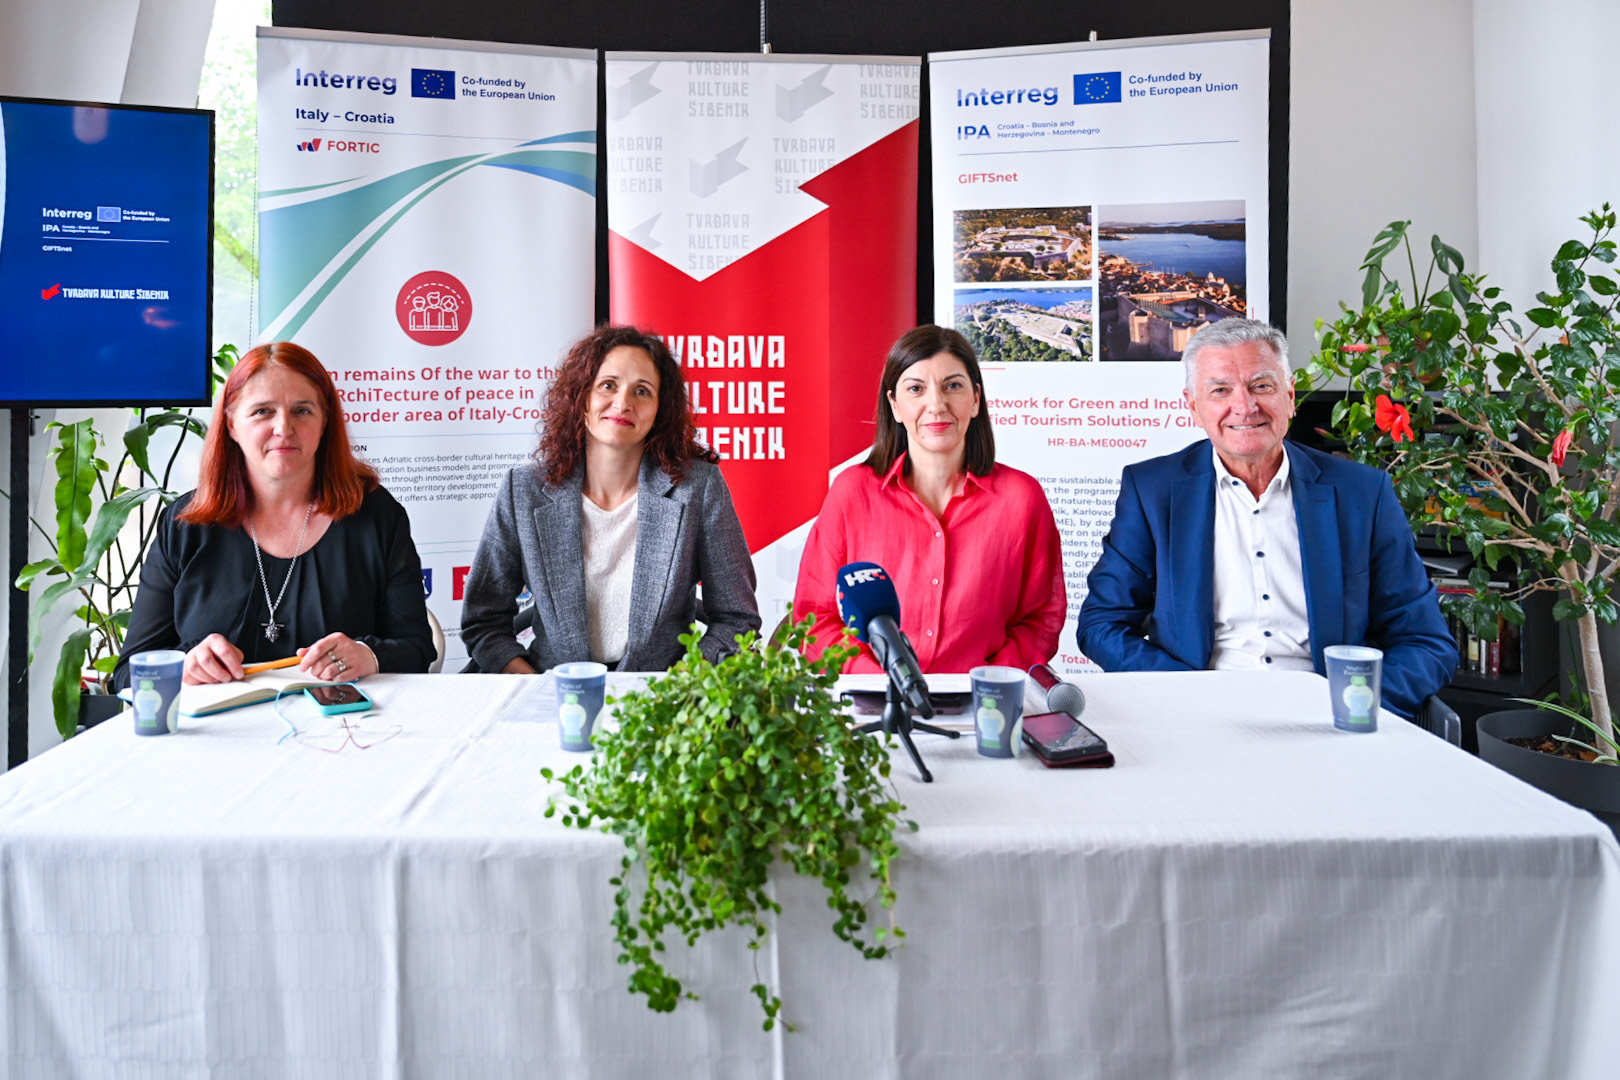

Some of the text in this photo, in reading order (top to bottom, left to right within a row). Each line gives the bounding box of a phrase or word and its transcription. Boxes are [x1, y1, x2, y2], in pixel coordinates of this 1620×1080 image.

[296, 68, 397, 95] Interreg
[462, 76, 526, 89] Co-funded by
[1129, 71, 1202, 84] Co-funded by
[462, 88, 556, 101] the European Union
[689, 82, 749, 96] KULTURE
[860, 84, 919, 99] KULTURE
[1129, 82, 1238, 97] the European Union
[957, 87, 1058, 107] Interreg
[296, 108, 329, 123] Italy
[345, 111, 395, 124] Croatia
[1032, 121, 1058, 129] Bosnia
[957, 125, 991, 140] IPA
[997, 131, 1045, 139] Herzegovina
[1052, 128, 1100, 136] Montenegro
[328, 140, 380, 153] FORTIC
[772, 138, 835, 152] TVRĐAVA
[958, 172, 1018, 184] GIFTSnet
[42, 207, 92, 220] Interreg
[687, 214, 749, 228] TVRĐAVA
[42, 224, 60, 232] IPA
[689, 235, 749, 249] KULTURE
[660, 335, 785, 368] VRĐAVA
[344, 367, 415, 381] remains
[421, 366, 440, 380] Of
[445, 366, 473, 380] the
[478, 369, 509, 380] war
[515, 368, 531, 380] to
[336, 386, 534, 404] RchiTecture of peace in
[986, 397, 1038, 409] etwork
[1043, 397, 1065, 409] for
[1069, 398, 1115, 409] Green
[1119, 398, 1149, 409] and
[343, 408, 399, 423] border
[405, 410, 442, 422] area
[448, 407, 465, 421] of
[1021, 414, 1083, 426] Tourism
[1087, 415, 1161, 427] Solutions
[1047, 438, 1147, 448] HR-BA-ME00047
[414, 454, 463, 462] cross-border
[465, 453, 493, 461] cultural
[495, 453, 526, 461] heritage
[392, 475, 423, 484] through
[425, 473, 464, 481] innovative
[466, 473, 490, 481] digital
[1059, 476, 1113, 484] sustainable
[414, 484, 446, 492] territory
[447, 482, 498, 491] development,
[436, 493, 468, 501] strategic
[1073, 508, 1113, 516] Karlovac
[1080, 518, 1091, 527] by
[1063, 550, 1089, 559] endly
[844, 568, 883, 587] HRT
[1061, 654, 1090, 664] Total
